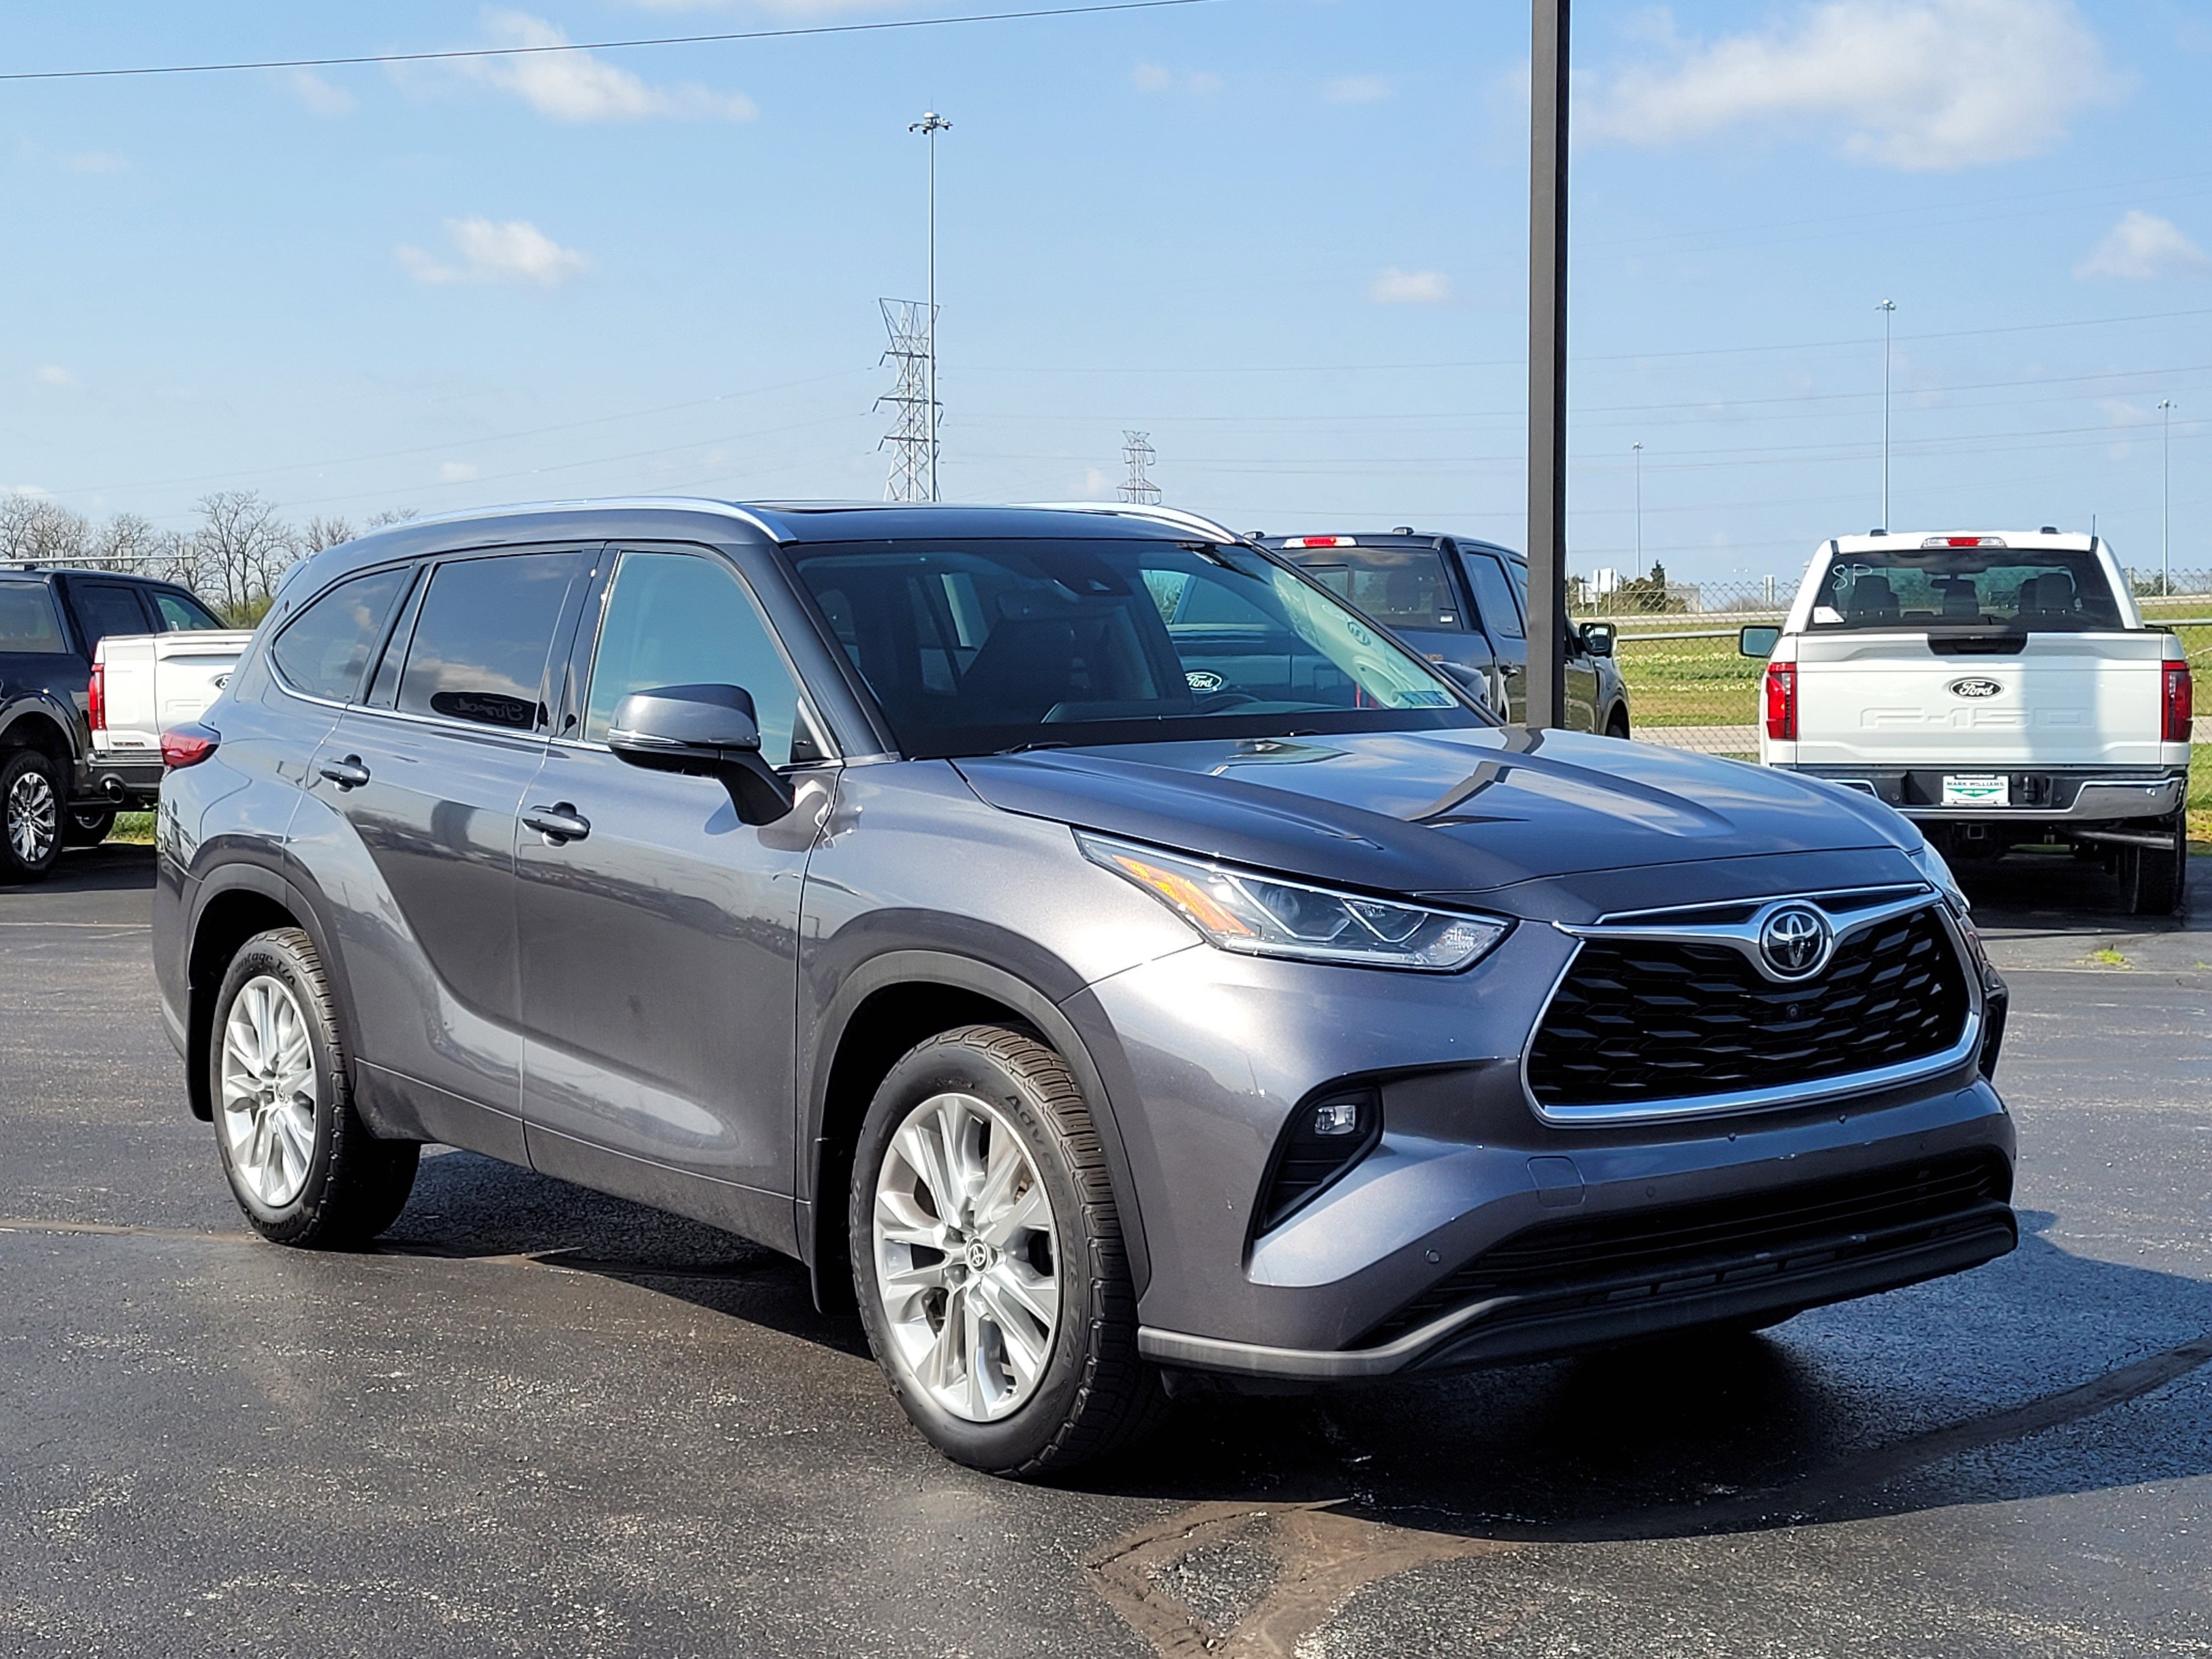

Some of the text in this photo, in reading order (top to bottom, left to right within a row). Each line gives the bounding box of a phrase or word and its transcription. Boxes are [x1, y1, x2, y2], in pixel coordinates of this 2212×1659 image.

[1186, 674, 1214, 687] Ford
[1959, 682, 1994, 696] Ford
[1860, 708, 2095, 729] F-150
